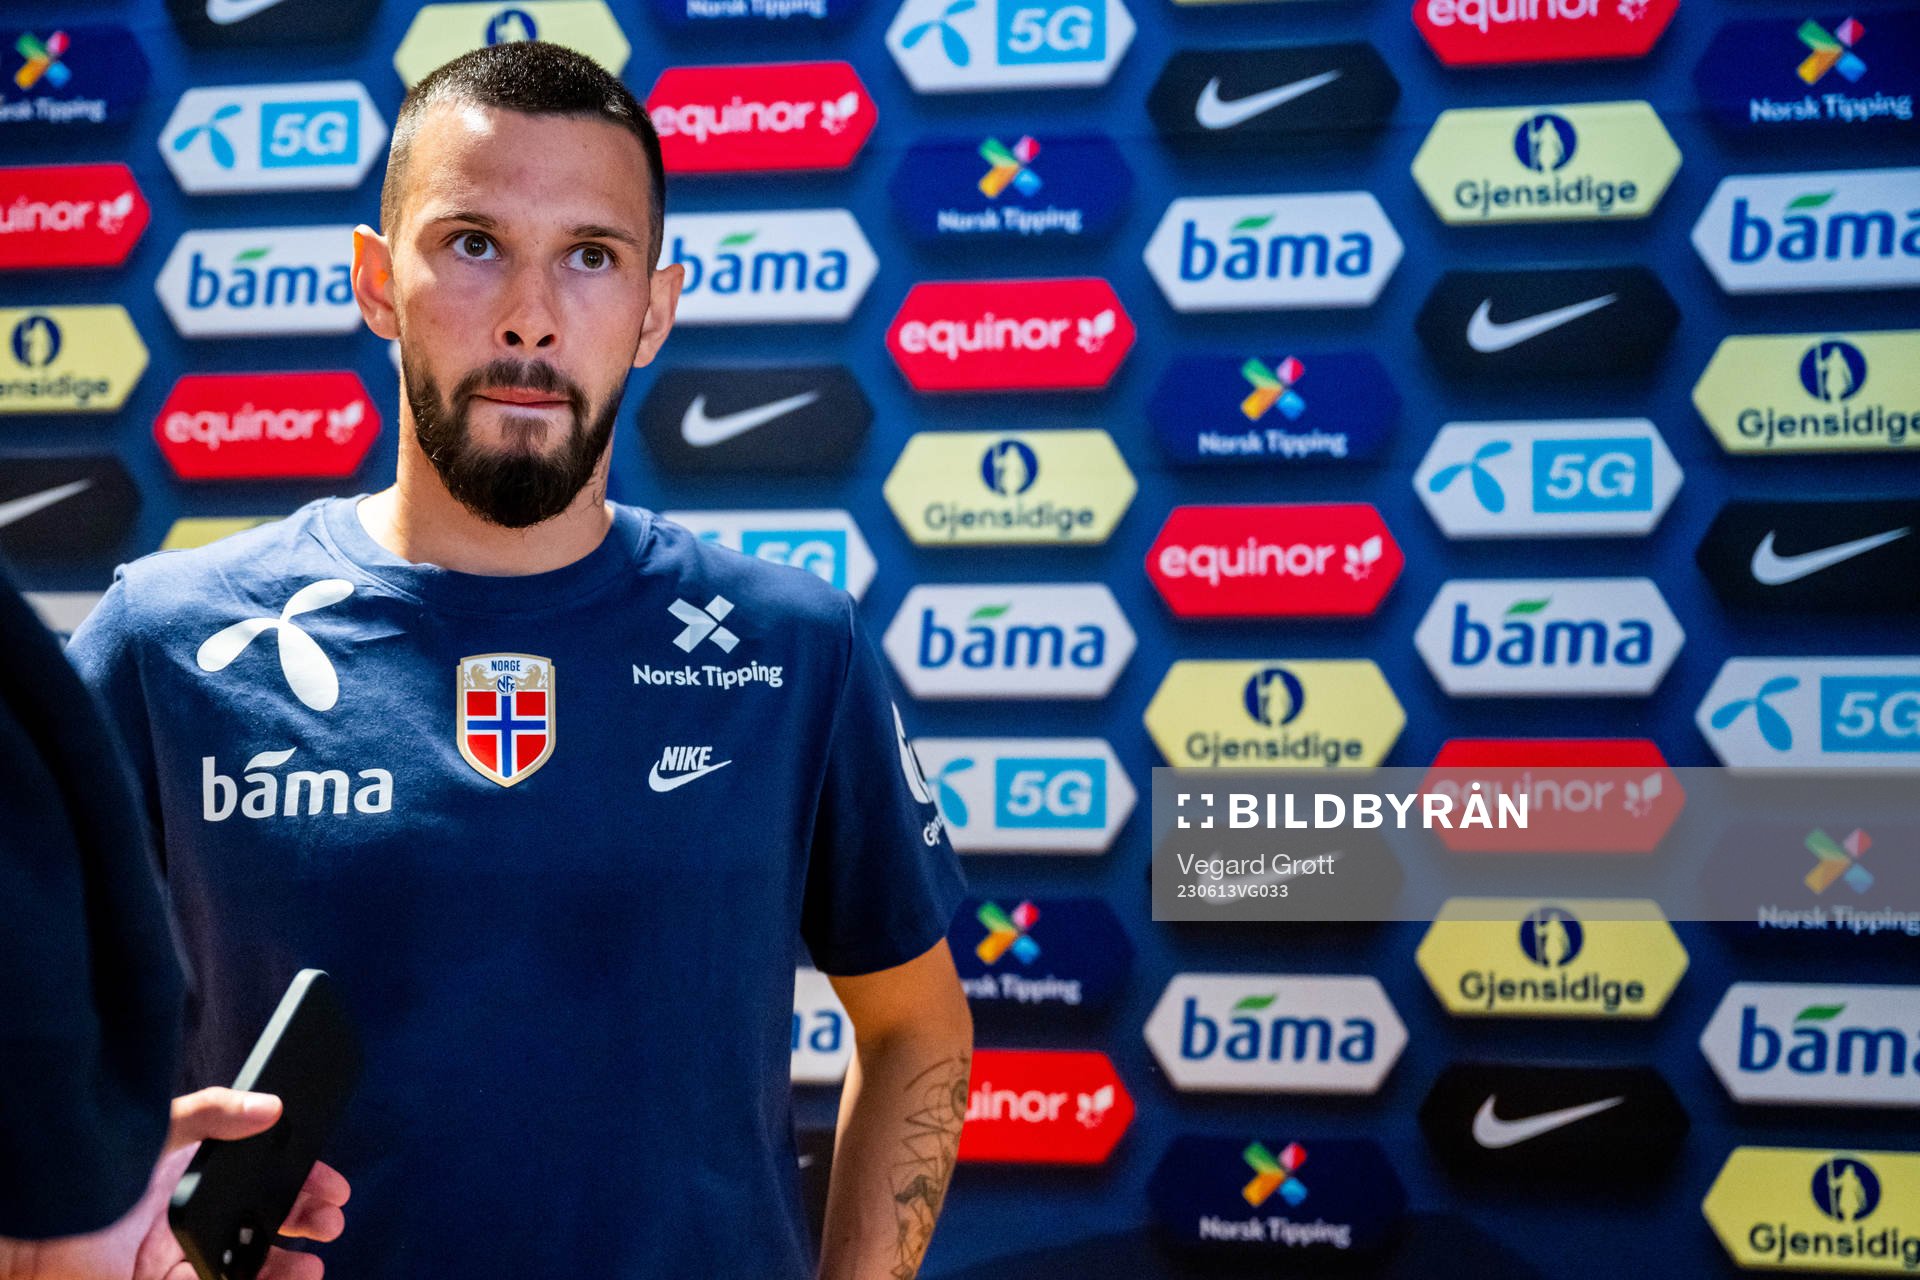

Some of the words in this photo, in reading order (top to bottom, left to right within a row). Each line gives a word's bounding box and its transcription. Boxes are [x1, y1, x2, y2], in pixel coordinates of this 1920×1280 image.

[1007, 6, 1092, 53] 5G
[652, 97, 815, 143] equinor
[1750, 97, 1820, 122] Norsk
[1824, 92, 1912, 121] Tipping
[270, 111, 348, 157] 5G
[1454, 177, 1638, 215] Gjensidige
[938, 209, 999, 232] Norsk
[1002, 207, 1082, 234] Tipping
[899, 312, 1067, 360] equinor
[164, 410, 319, 453] equinor
[1198, 432, 1261, 455] Norsk
[1264, 428, 1348, 458] Tipping
[1545, 452, 1636, 500] 5G
[924, 503, 1095, 533] Gjensidige
[1159, 537, 1335, 586] equinor
[491, 660, 521, 672] NORGE
[633, 664, 701, 688] Norsk
[702, 661, 783, 690] Tipping
[1836, 691, 1920, 738] 5G
[659, 746, 713, 771] NIKE
[1185, 730, 1363, 767] Gjensidige
[1006, 770, 1093, 817] 5G
[1459, 970, 1645, 1011] Gjensidige
[1200, 1215, 1265, 1241] Norsk
[1267, 1216, 1351, 1249] Tipping
